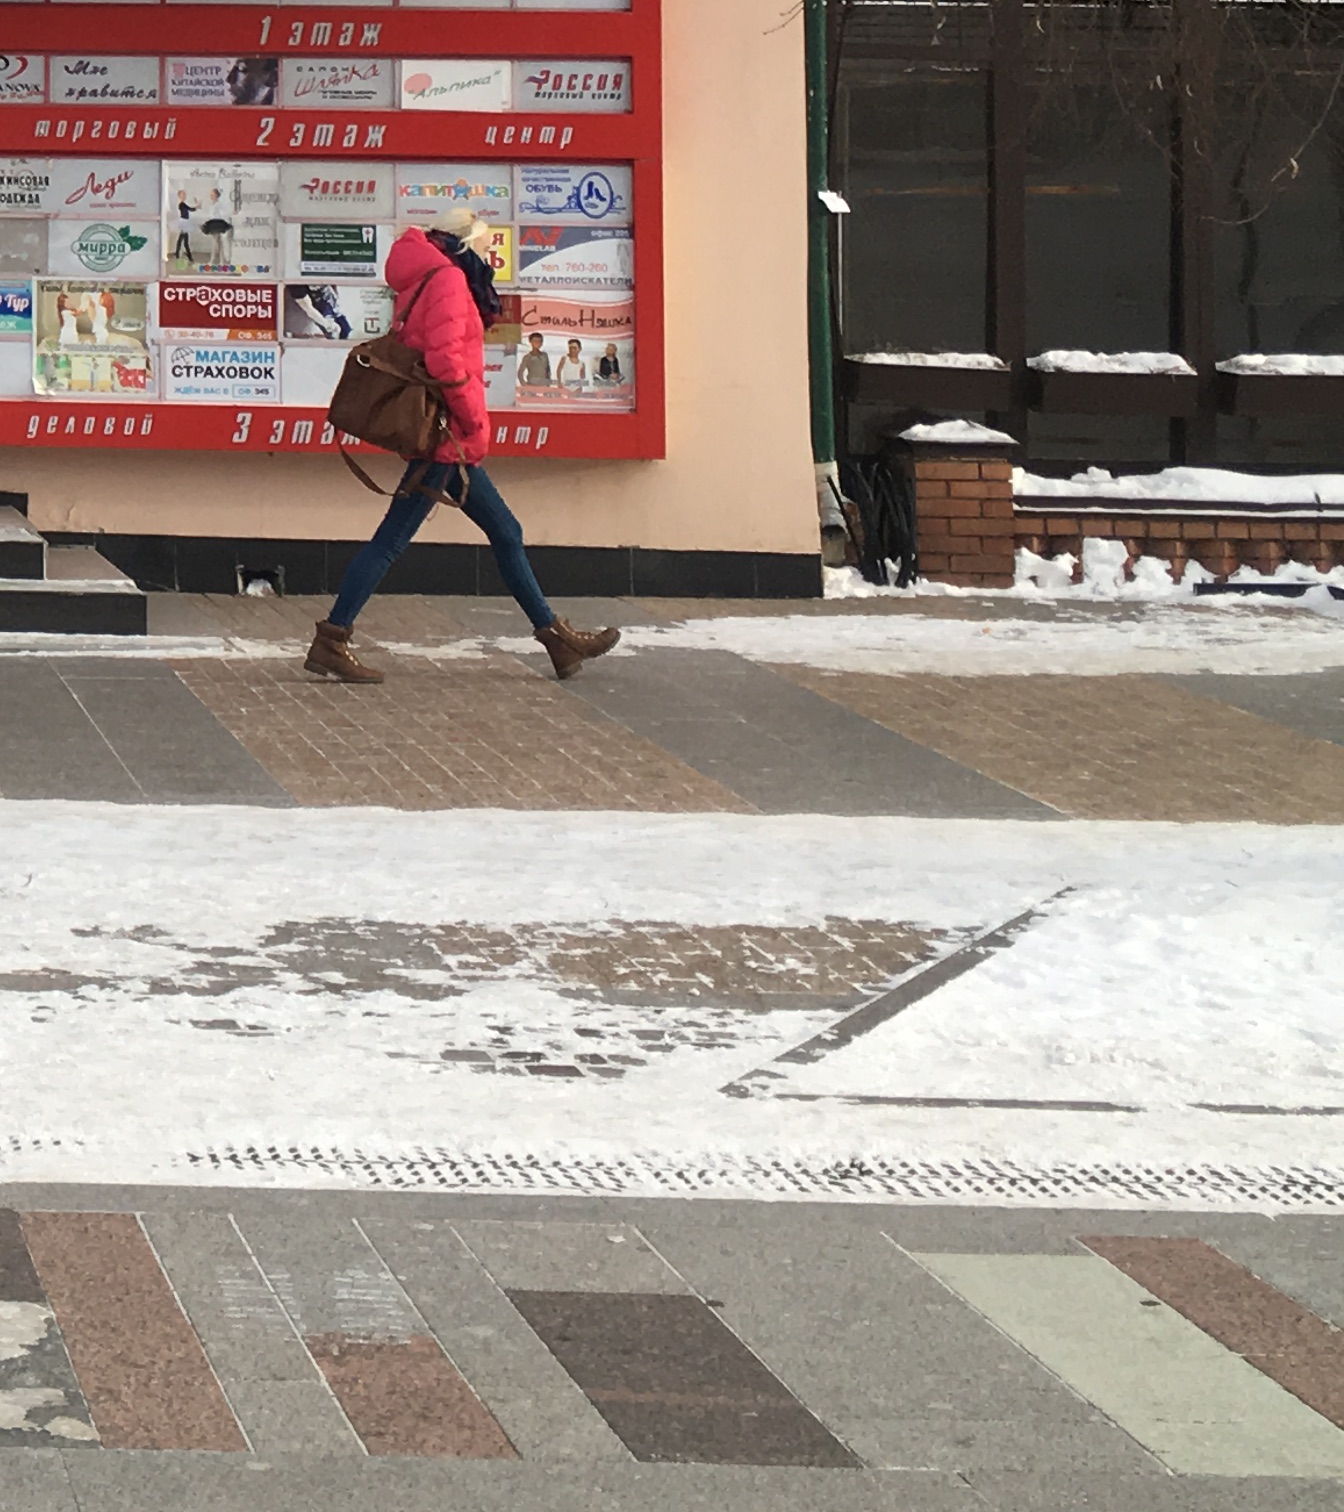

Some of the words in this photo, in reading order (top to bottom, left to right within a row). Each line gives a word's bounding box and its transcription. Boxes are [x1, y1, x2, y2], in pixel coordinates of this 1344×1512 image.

[260, 16, 272, 45] 1
[288, 22, 383, 46] этаж
[185, 66, 222, 76] ЦЕНТР
[34, 118, 177, 144] торговый
[256, 117, 275, 146] 2
[289, 123, 387, 148] этаж
[484, 126, 573, 149] центр
[65, 170, 134, 205] Леди
[526, 184, 562, 194] ОБУВЬ
[209, 304, 272, 319] СПОРЫ
[195, 350, 275, 364] МАГАЗИН
[171, 365, 275, 380] СТРАХОВОК
[27, 414, 153, 438] деловой
[232, 412, 252, 443] 3
